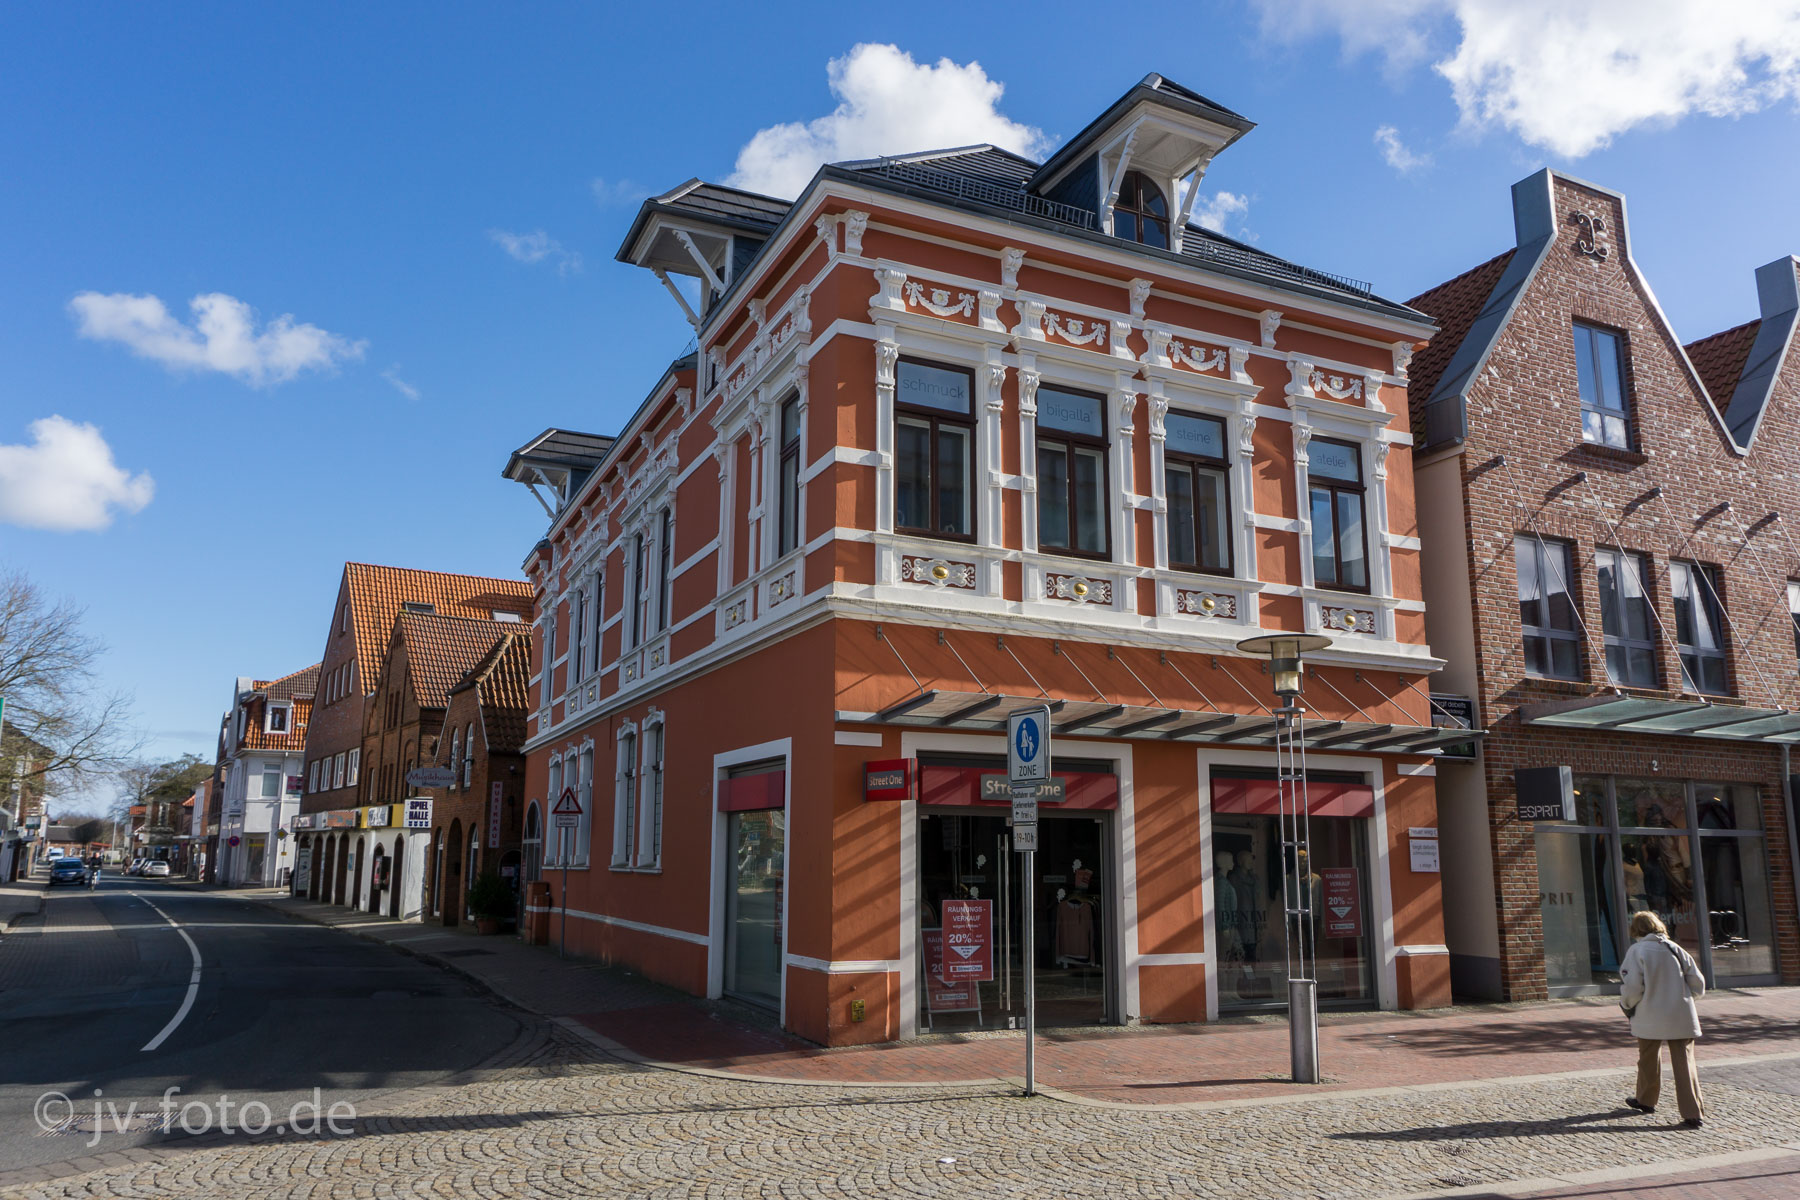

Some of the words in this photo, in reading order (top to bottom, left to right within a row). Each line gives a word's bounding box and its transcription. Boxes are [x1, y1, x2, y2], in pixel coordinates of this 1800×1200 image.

[902, 378, 965, 400] schmuck
[1176, 428, 1211, 445] steine
[1315, 453, 1347, 469] atelier
[1019, 765, 1037, 776] ZONE
[1652, 760, 1659, 772] 2
[869, 776, 889, 787] Street
[889, 774, 903, 785] One
[986, 780, 1012, 795] Stre
[409, 801, 428, 810] SPIEL
[1519, 804, 1561, 819] ESPRIT
[408, 811, 428, 820] HALLE
[491, 783, 501, 846] MUSIKHAUS
[1328, 897, 1346, 905] 20%
[1540, 892, 1575, 905] PRIT
[948, 933, 972, 944] 20%
